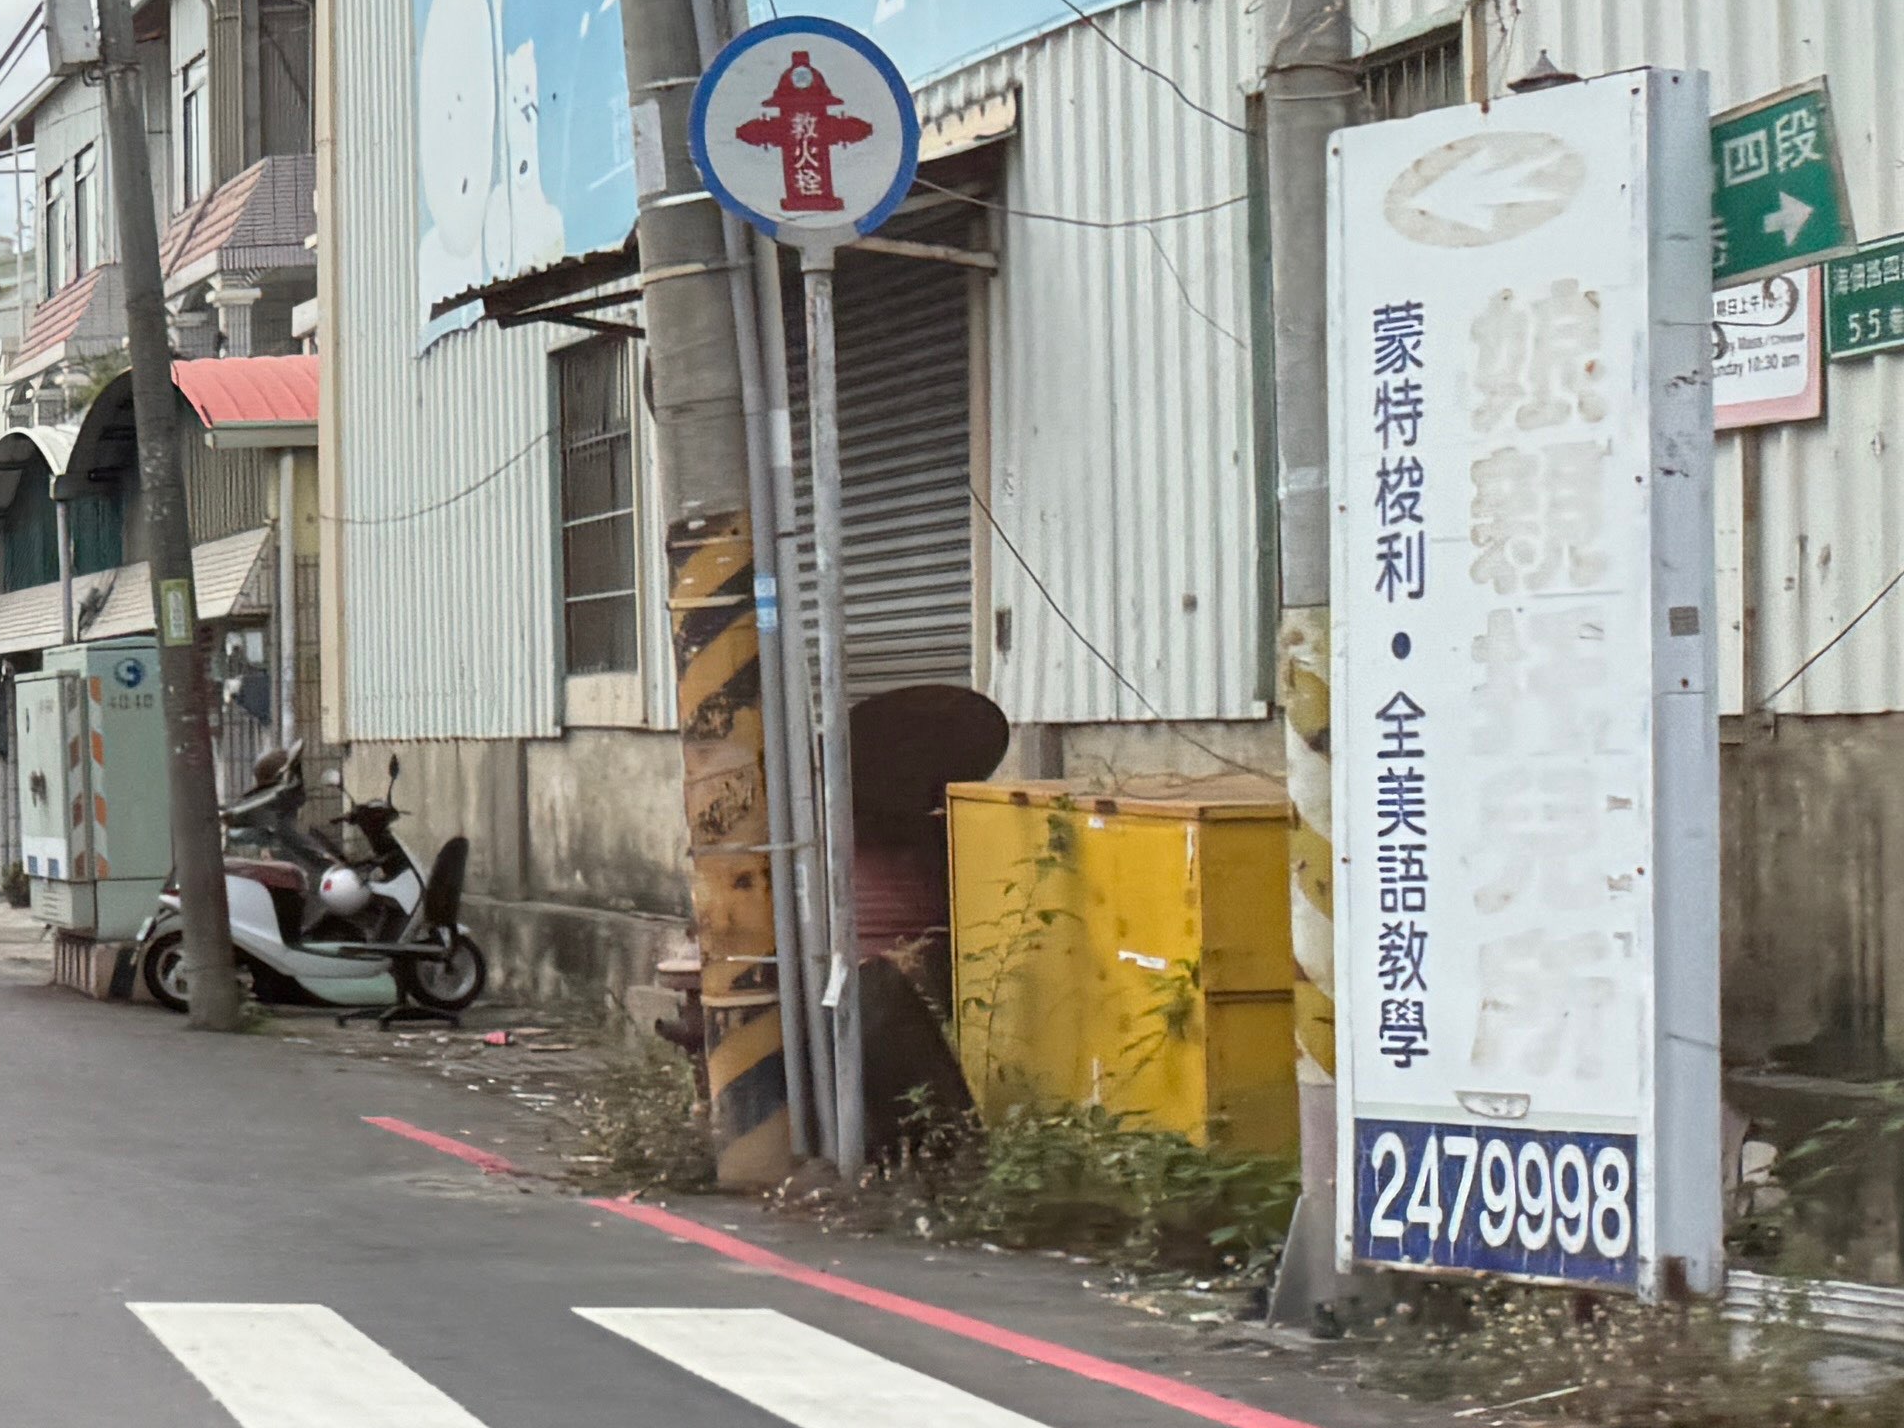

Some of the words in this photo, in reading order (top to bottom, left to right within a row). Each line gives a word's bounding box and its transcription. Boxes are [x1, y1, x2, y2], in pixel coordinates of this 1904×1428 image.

[791, 111, 824, 196] 救火栓
[1724, 108, 1823, 188] 四段
[1370, 1131, 1631, 1258] 2479998
